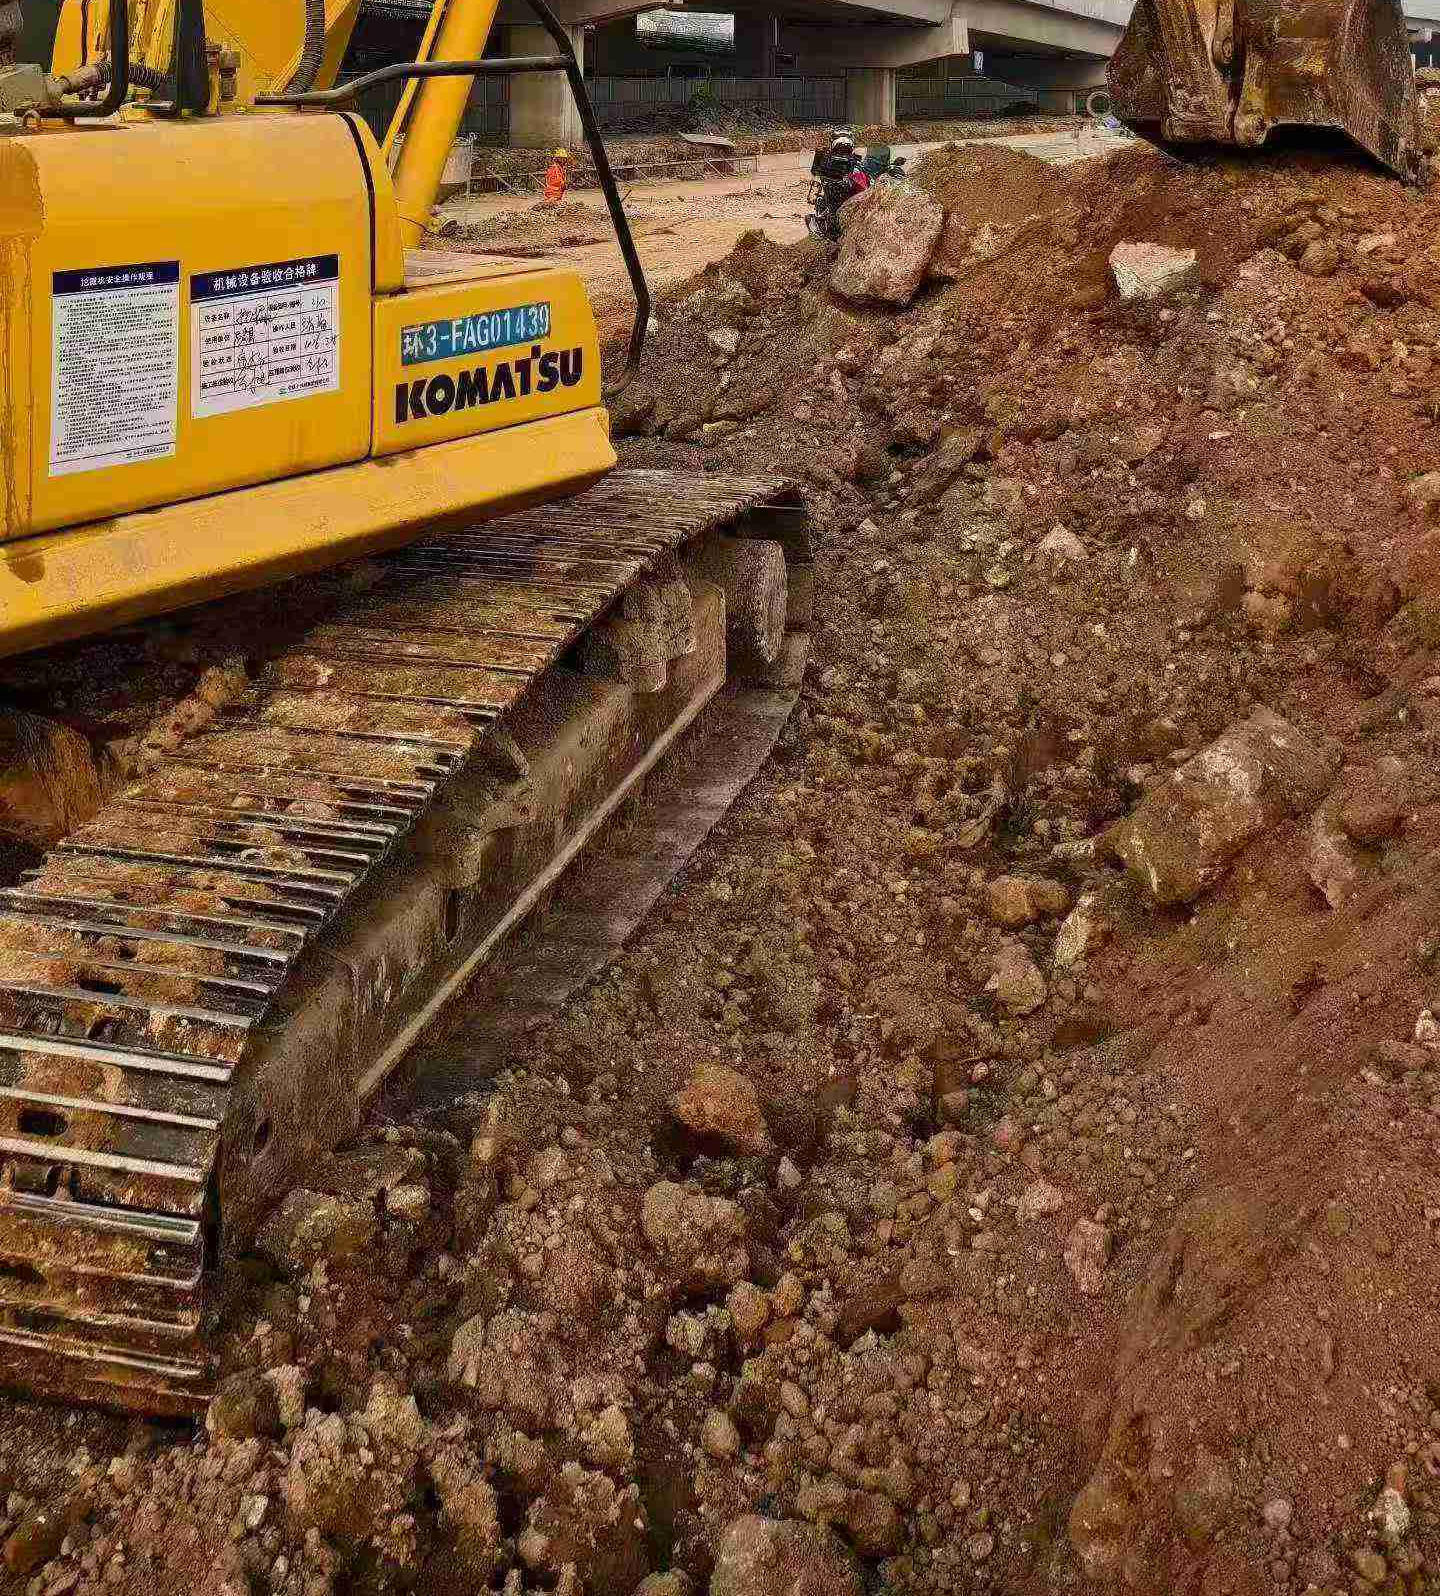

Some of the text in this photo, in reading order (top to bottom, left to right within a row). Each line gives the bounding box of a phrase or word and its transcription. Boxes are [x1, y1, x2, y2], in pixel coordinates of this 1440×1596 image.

[213, 264, 317, 291] 机械设备验收合格牌
[395, 345, 583, 423] KOMATSU
